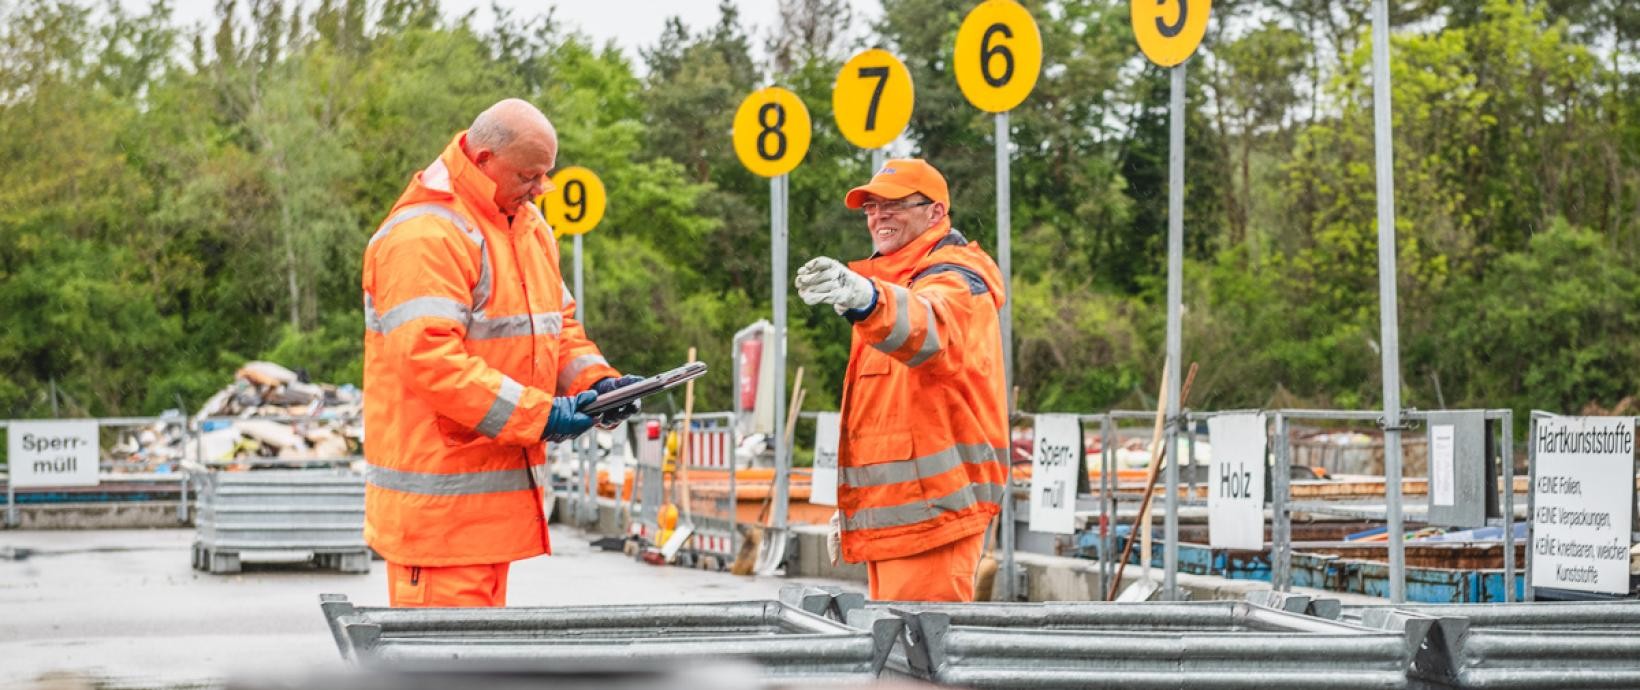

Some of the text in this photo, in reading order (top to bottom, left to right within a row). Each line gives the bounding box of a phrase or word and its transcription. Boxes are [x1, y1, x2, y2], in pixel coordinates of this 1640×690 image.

[1155, 0, 1188, 38] 5
[980, 23, 1015, 88] 6
[858, 66, 890, 131] 7
[756, 102, 787, 161] 8
[563, 179, 587, 222] 9
[22, 433, 87, 452] Sperr-
[1040, 437, 1074, 472] Sperr-
[33, 457, 77, 472] müll
[1220, 462, 1251, 498] Holz
[1537, 476, 1558, 494] KEINE
[1536, 507, 1557, 524] KEINE
[1535, 537, 1556, 556] KEINE
[1556, 564, 1599, 584] Kunststoffe
